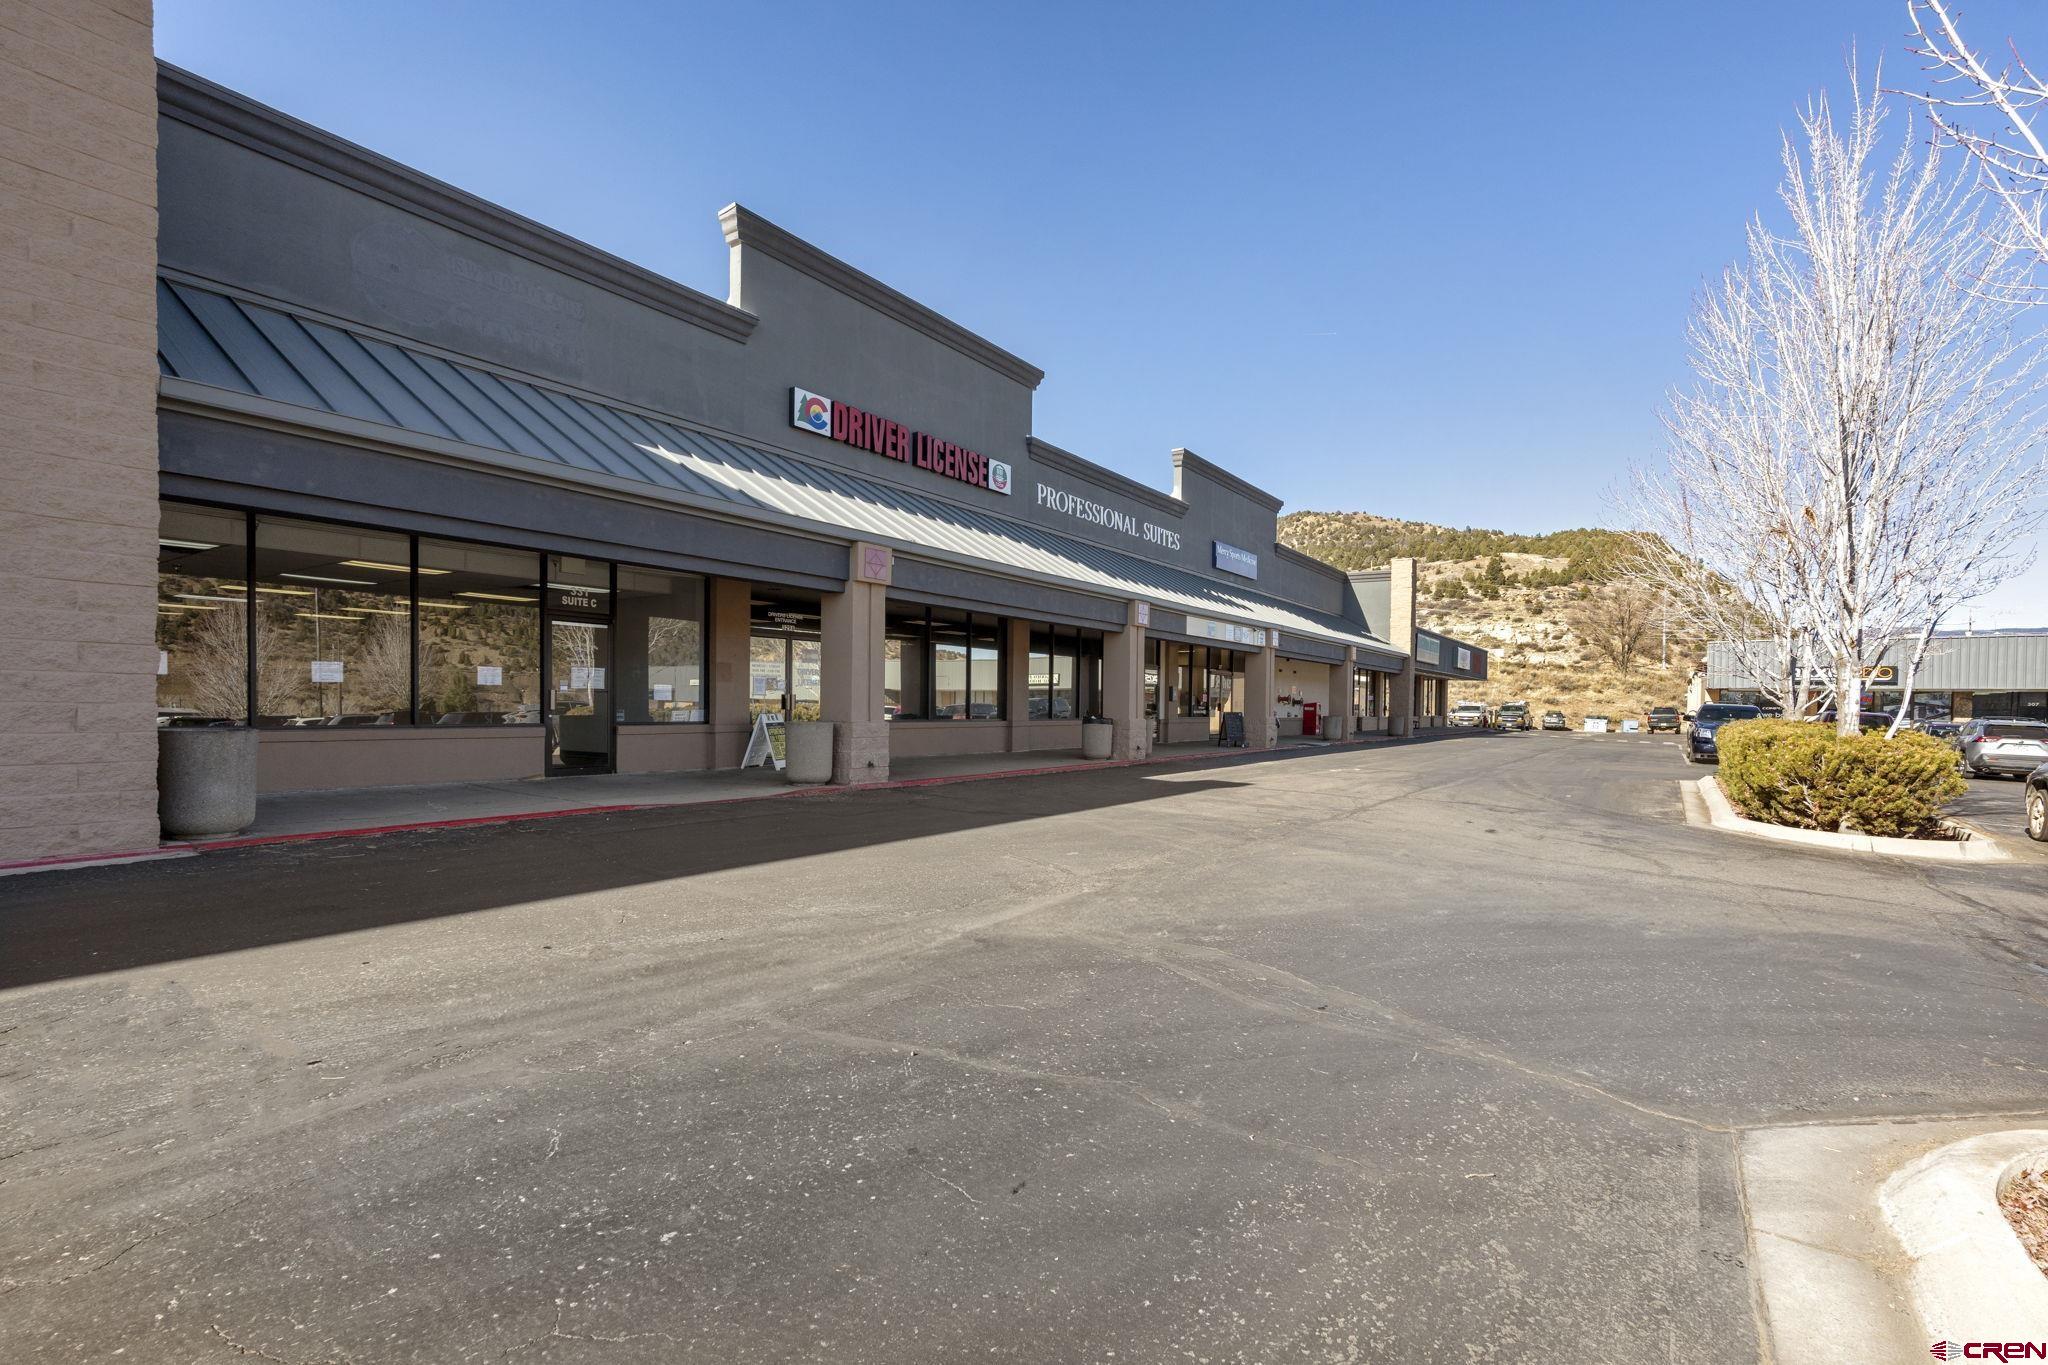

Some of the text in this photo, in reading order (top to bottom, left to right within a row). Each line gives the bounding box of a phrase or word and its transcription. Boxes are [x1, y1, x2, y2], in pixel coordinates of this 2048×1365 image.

[832, 400, 988, 488] DRIVER LICENSE
[1036, 483, 1181, 551] PROFESSIONAL SUITES
[561, 596, 597, 608] SUITE C
